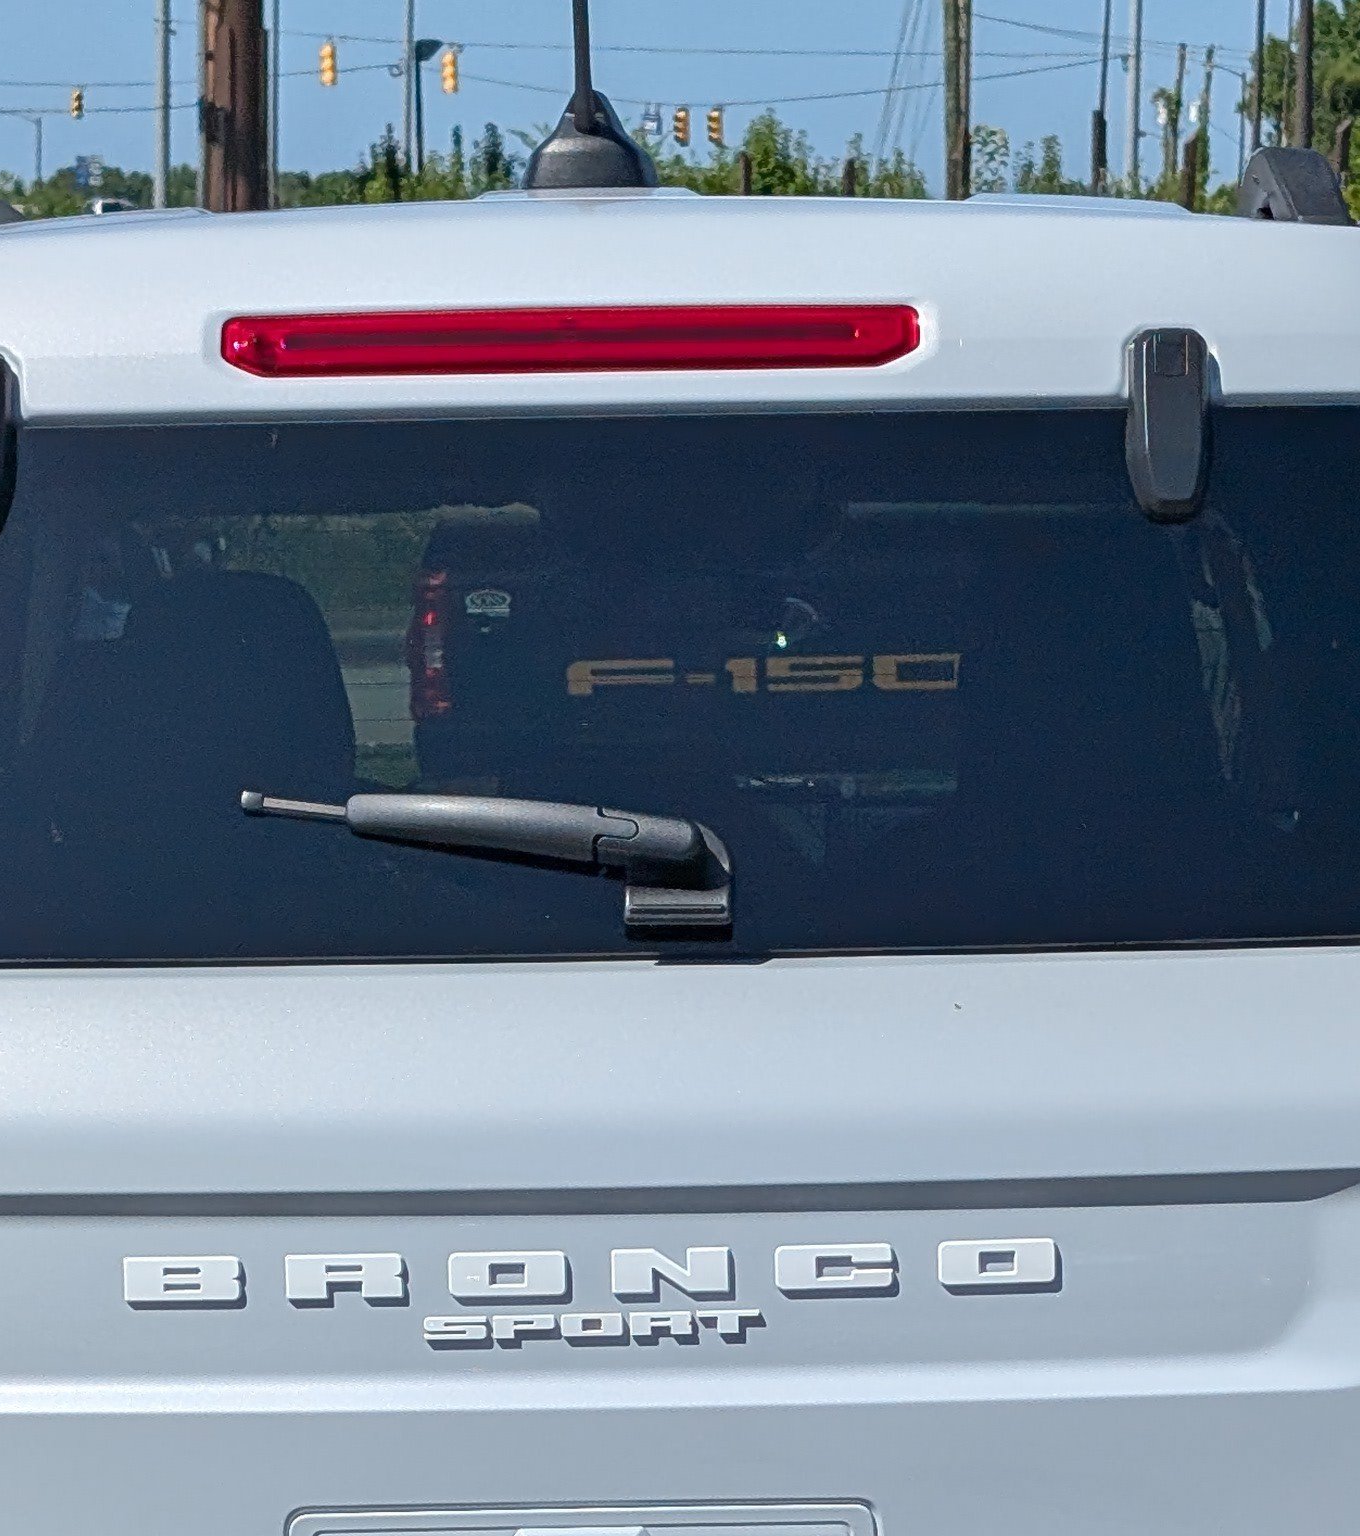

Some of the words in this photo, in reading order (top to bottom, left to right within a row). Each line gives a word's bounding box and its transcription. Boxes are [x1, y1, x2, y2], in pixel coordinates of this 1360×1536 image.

[566, 653, 961, 695] F-150
[123, 1237, 1061, 1310] BRONCO
[423, 1309, 766, 1350] SPORT
